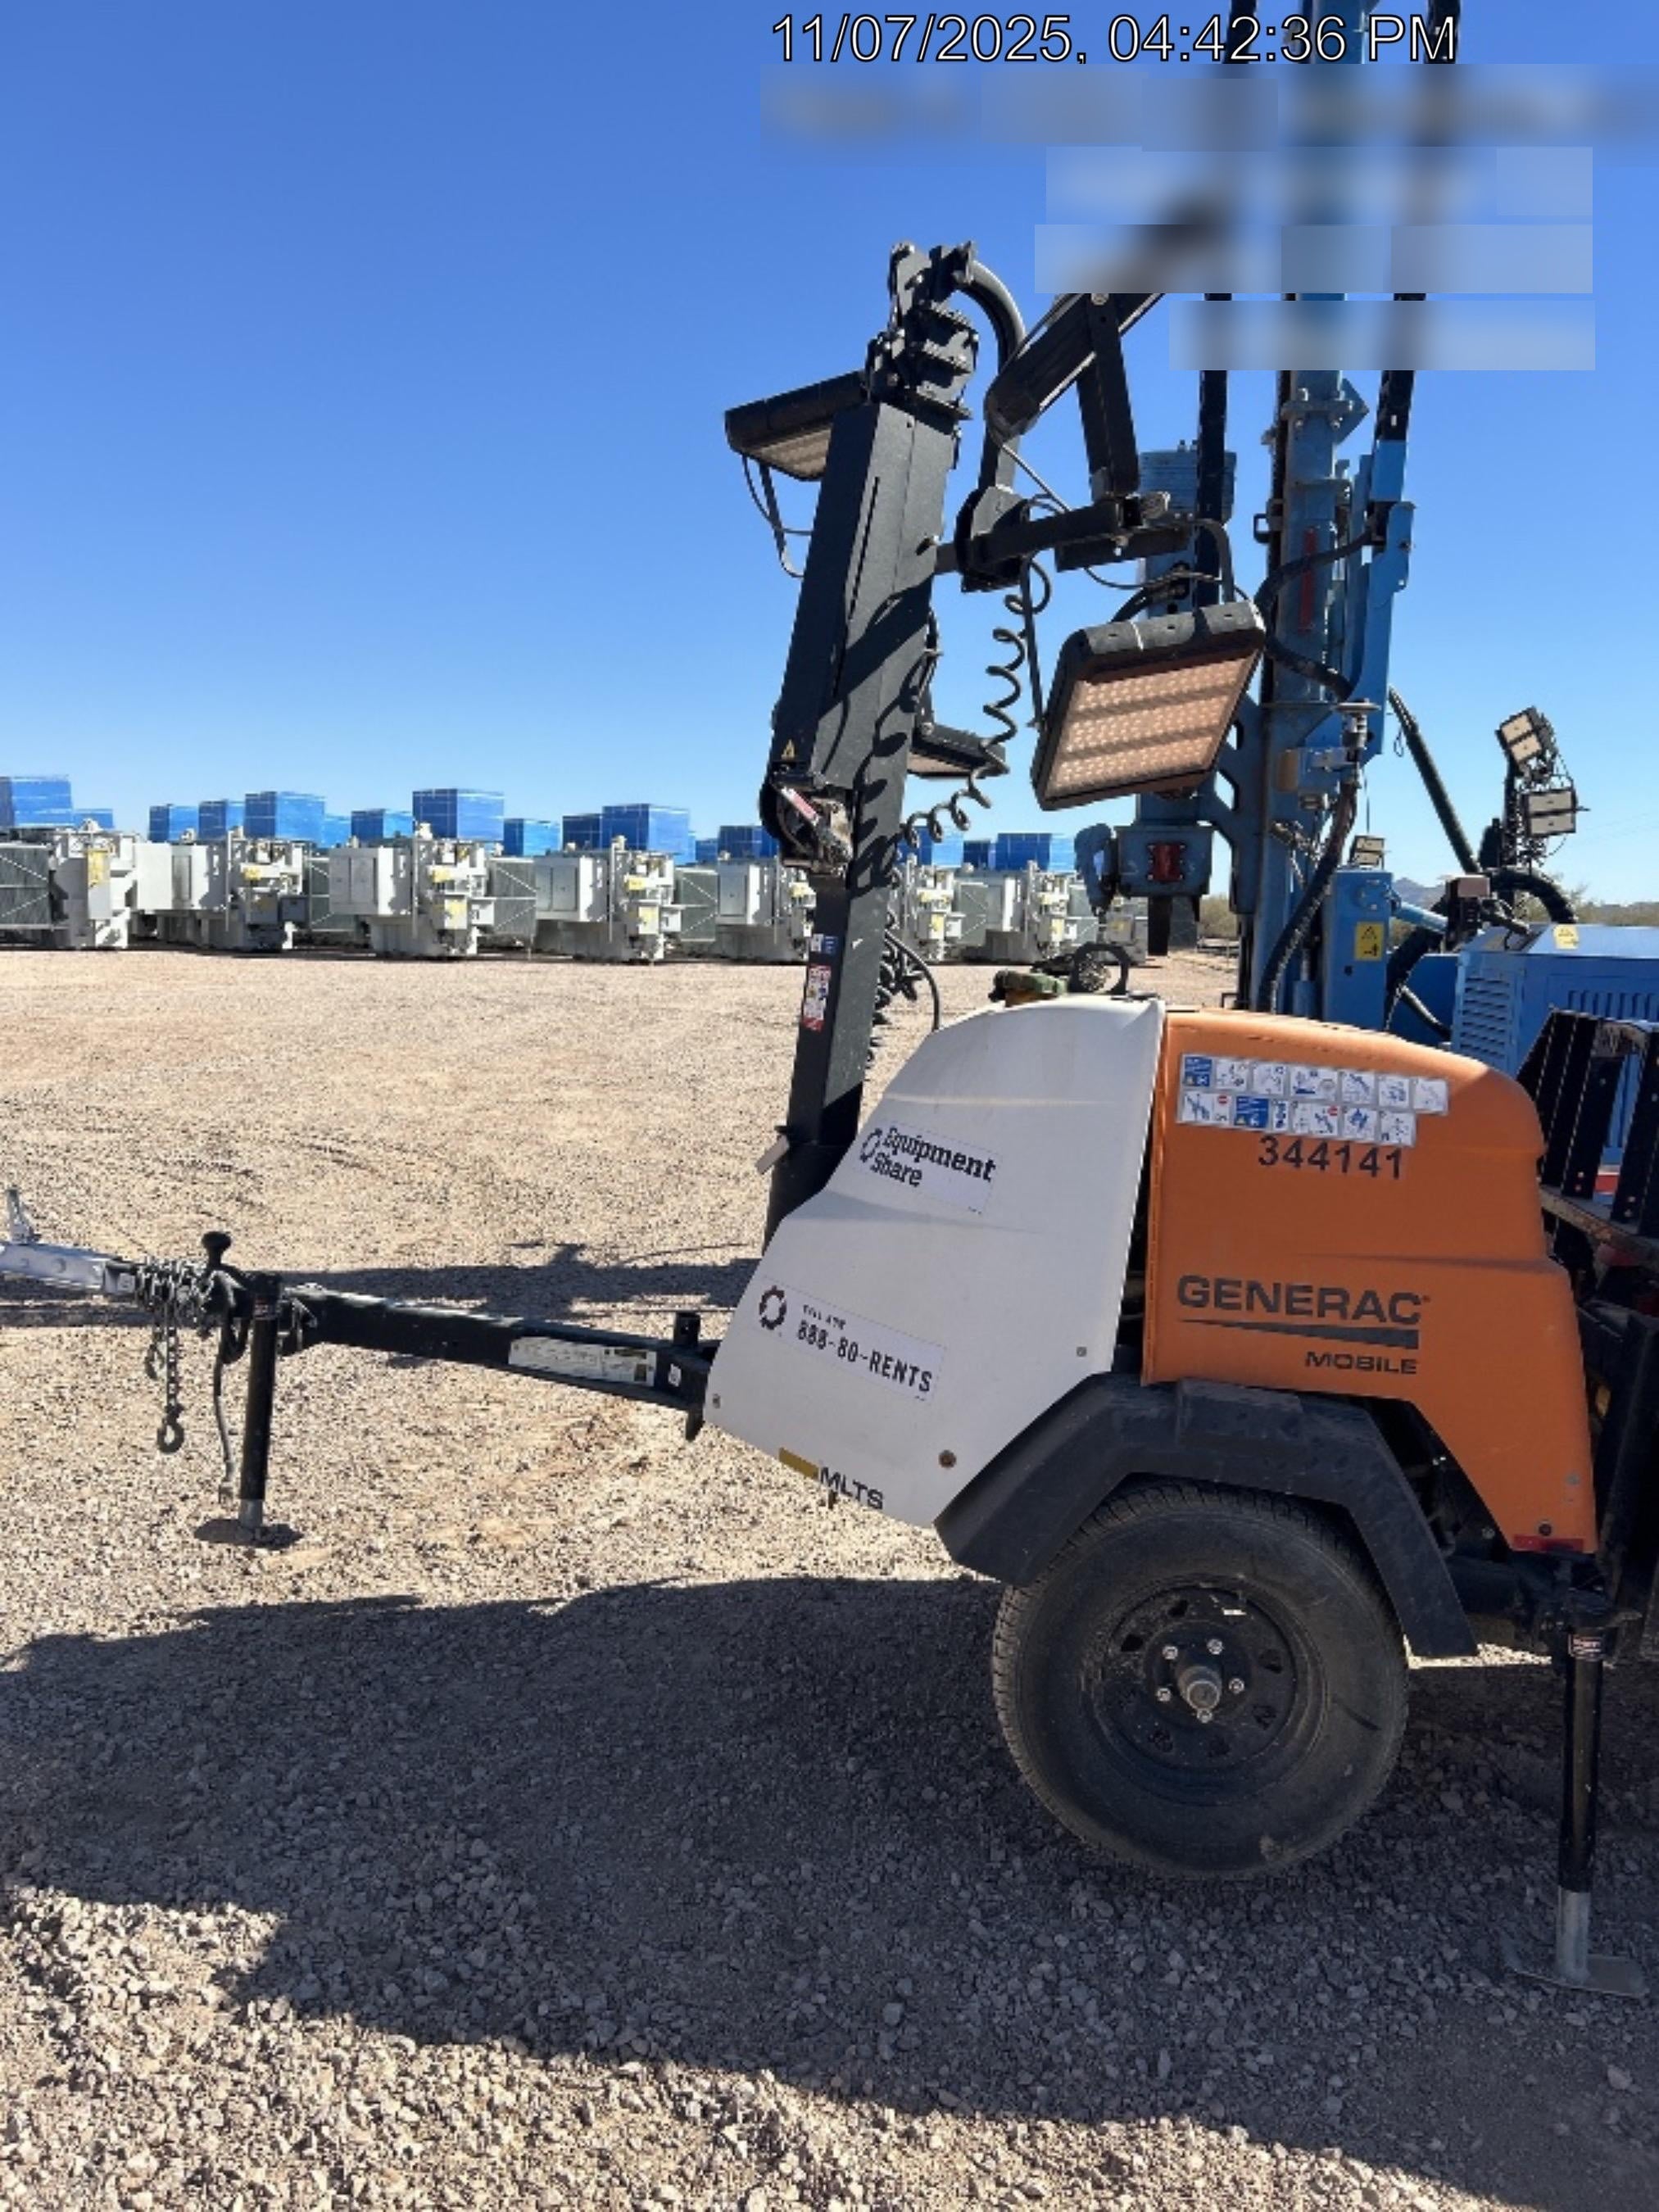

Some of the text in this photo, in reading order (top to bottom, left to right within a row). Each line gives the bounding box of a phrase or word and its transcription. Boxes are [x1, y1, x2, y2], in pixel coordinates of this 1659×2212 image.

[869, 1151, 922, 1188] Share
[882, 1126, 996, 1182] Equipment
[1258, 1135, 1403, 1179] 344141
[1177, 1274, 1422, 1325] GENERAC
[797, 1319, 932, 1393] 888-80-RENTS
[1304, 1351, 1417, 1375] MOBILE
[820, 1467, 884, 1510] MLTS
